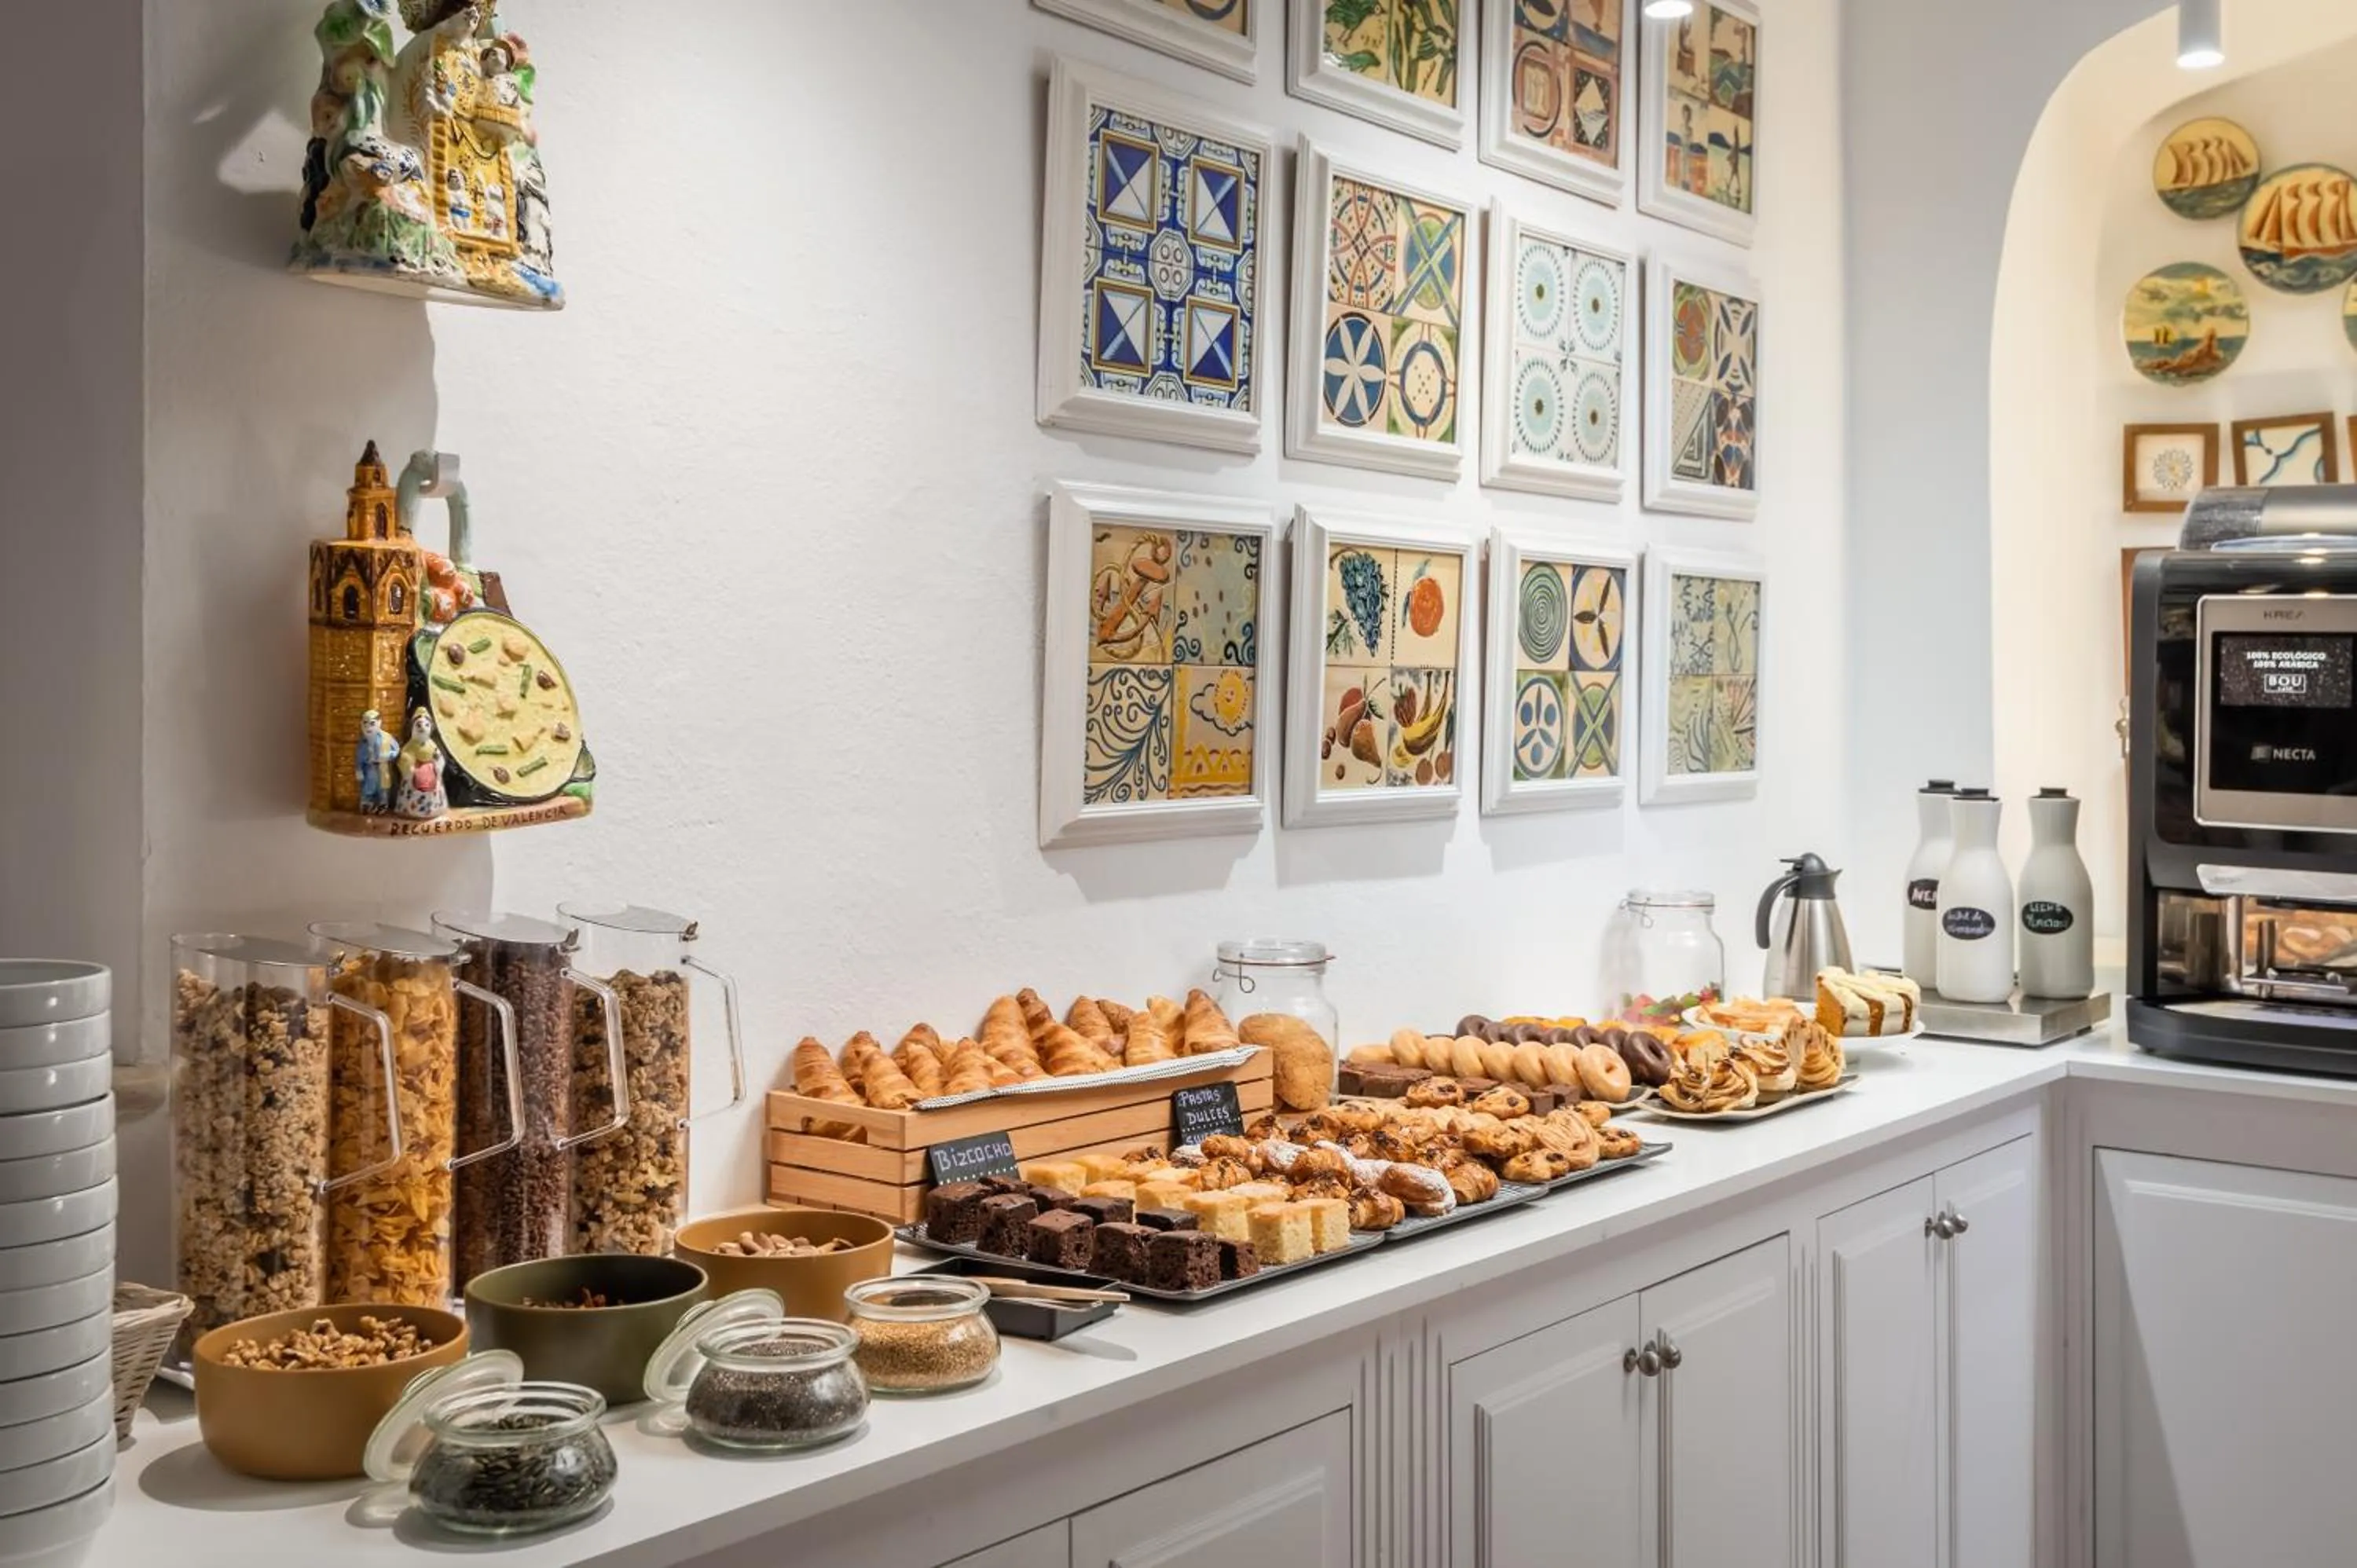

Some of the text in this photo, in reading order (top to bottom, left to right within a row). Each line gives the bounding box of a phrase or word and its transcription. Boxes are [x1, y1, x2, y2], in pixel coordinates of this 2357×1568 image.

[2247, 650, 2270, 660] 100%
[2253, 660, 2276, 669] 100%
[2268, 675, 2302, 687] BOU
[2273, 748, 2316, 761] NECTA
[482, 815, 498, 830] DE
[501, 805, 568, 826] VALENCIA
[1186, 1105, 1230, 1125] DULCES
